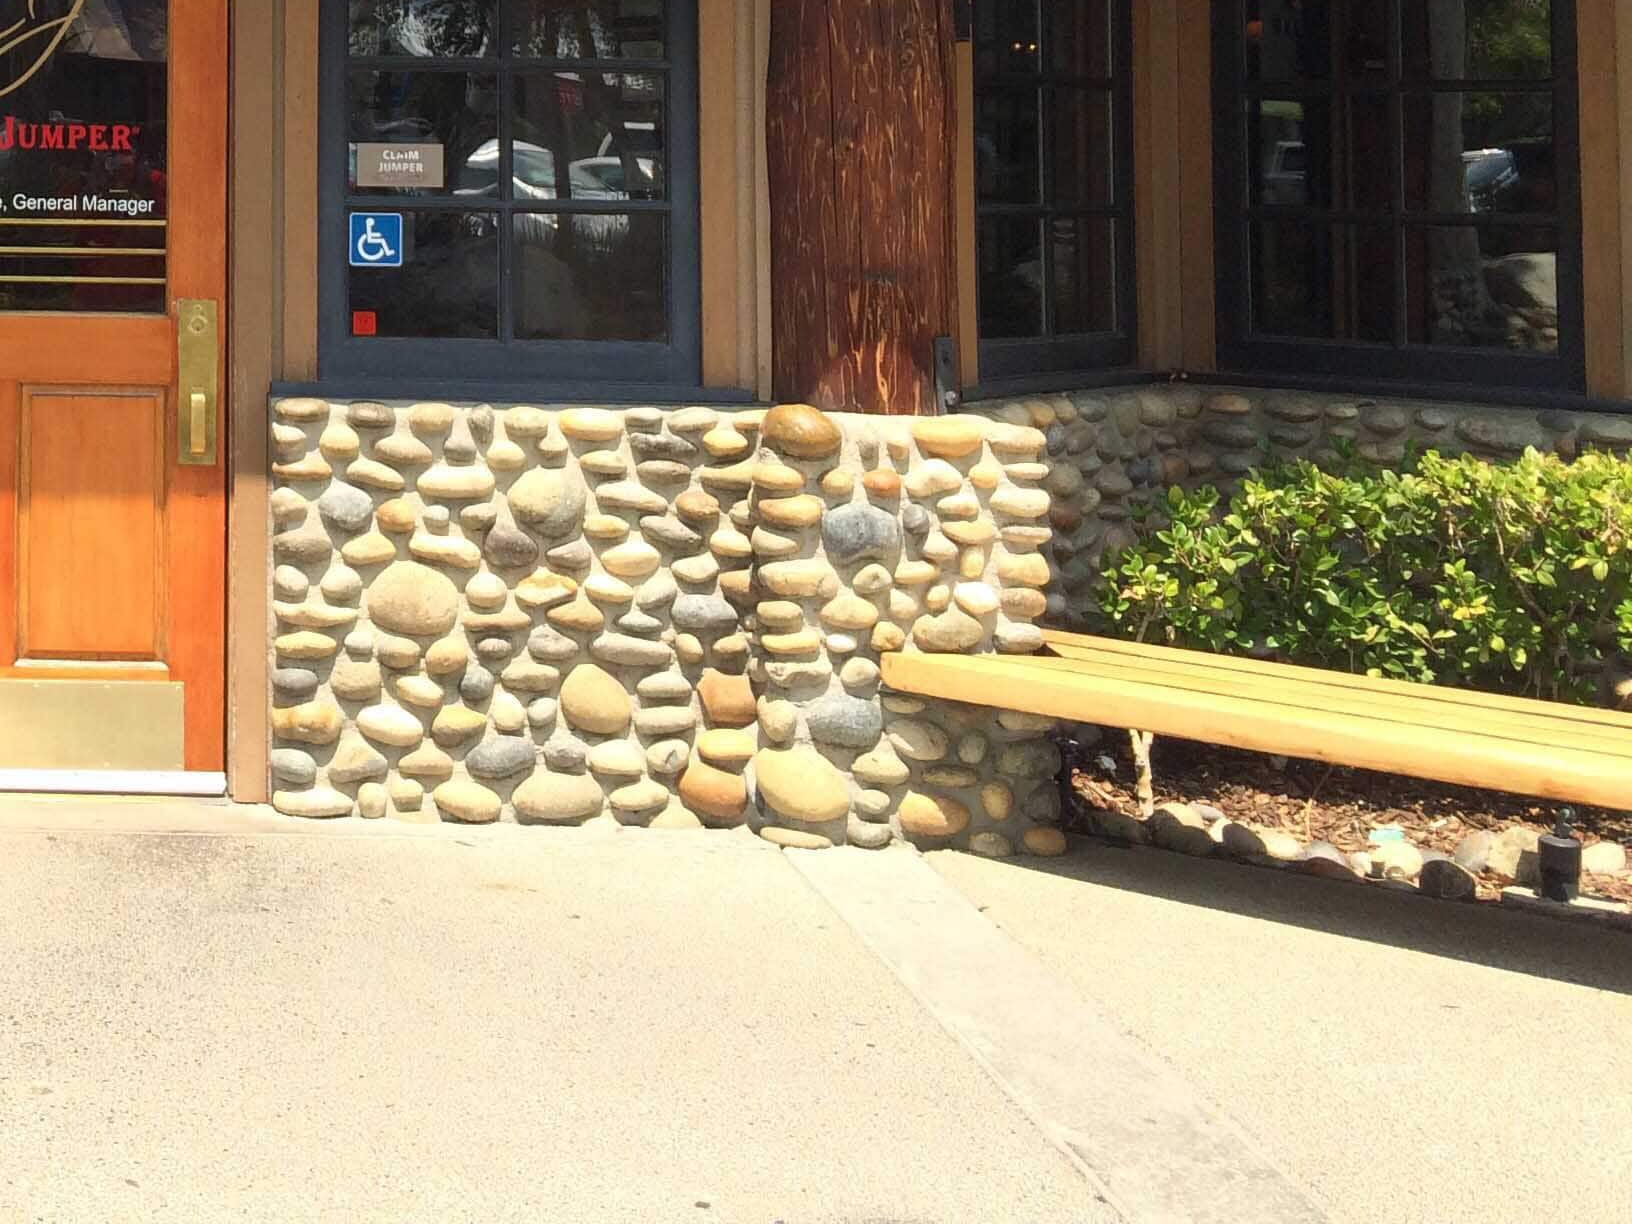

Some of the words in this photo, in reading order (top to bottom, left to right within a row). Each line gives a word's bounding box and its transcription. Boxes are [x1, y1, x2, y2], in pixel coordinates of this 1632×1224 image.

[382, 149, 420, 161] CLAIM
[378, 162, 424, 174] JUMPER
[12, 192, 78, 212] General
[82, 194, 156, 216] Manager
